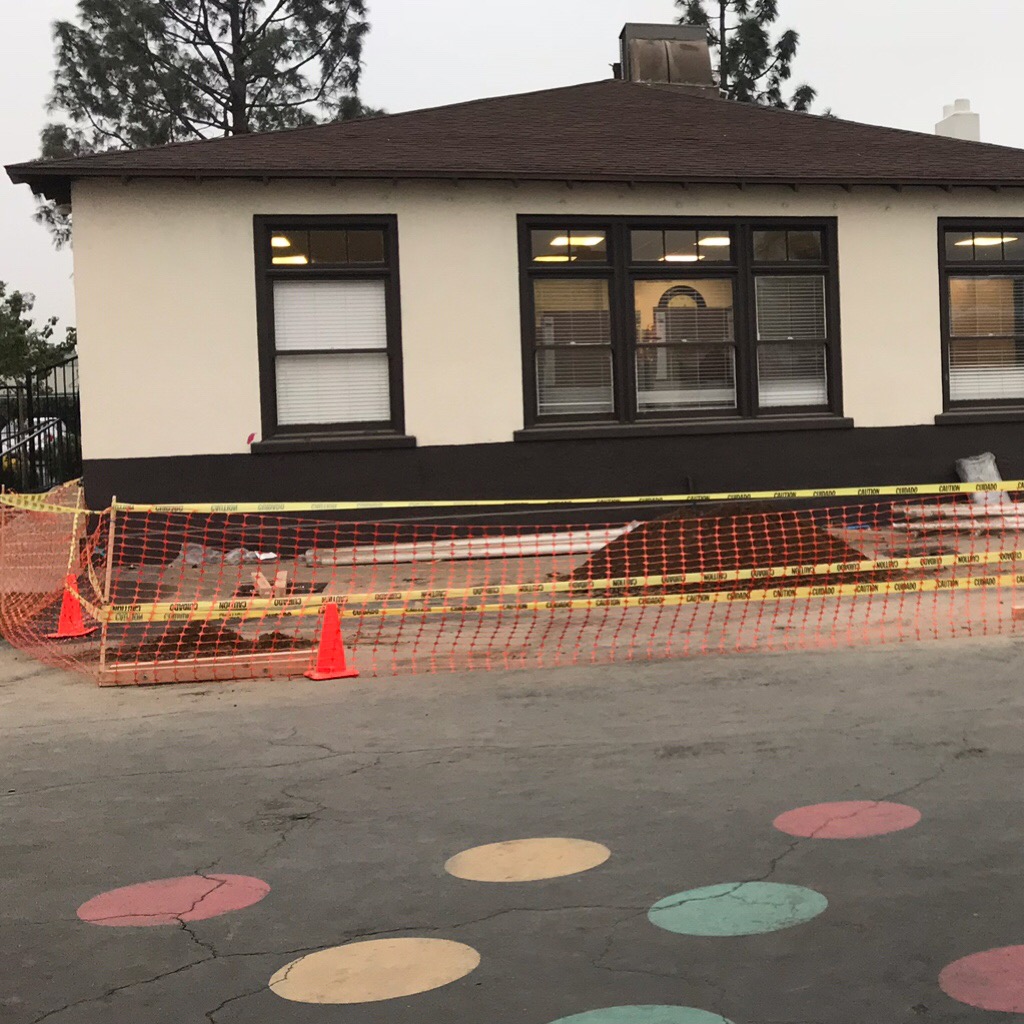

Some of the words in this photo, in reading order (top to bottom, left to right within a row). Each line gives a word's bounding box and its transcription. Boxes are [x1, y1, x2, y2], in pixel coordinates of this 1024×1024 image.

[939, 484, 961, 492] CAUTION
[976, 483, 997, 491] CUIDADO
[958, 555, 980, 563] CAUTION
[792, 567, 815, 575] CAUTION
[704, 572, 727, 581] CAUTION
[773, 589, 797, 598] CAUTION
[812, 587, 835, 596] CUIDADO
[856, 584, 879, 593] CAUTION
[894, 582, 917, 591] CUIDADO
[937, 580, 959, 588] CAUTION
[974, 578, 996, 586] CUIDADO
